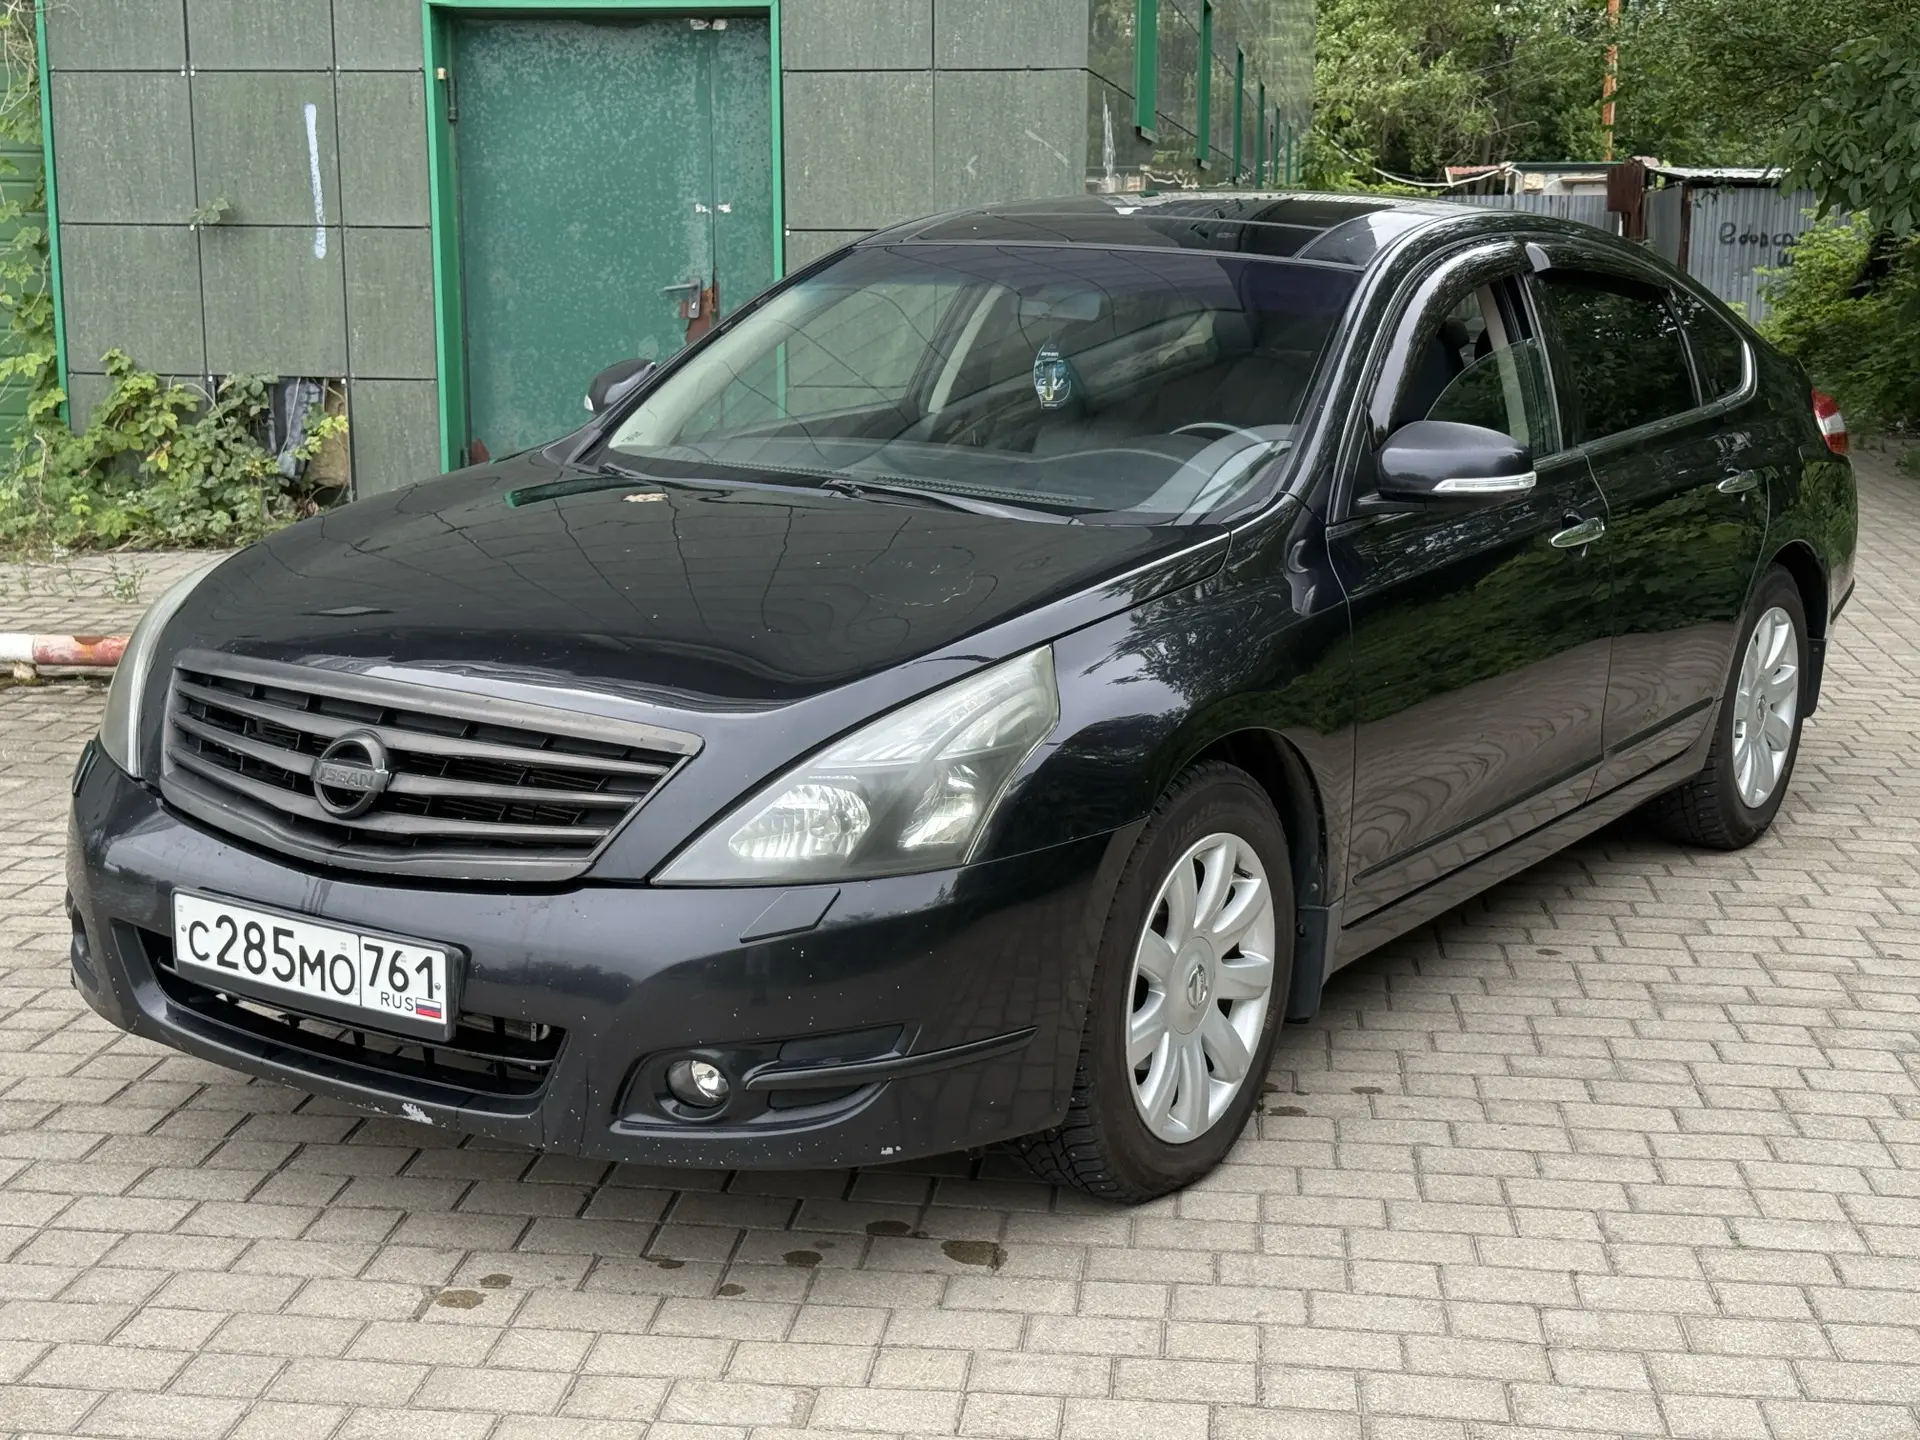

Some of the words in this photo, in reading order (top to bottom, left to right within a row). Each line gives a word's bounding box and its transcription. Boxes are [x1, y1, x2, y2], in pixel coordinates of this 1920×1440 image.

[315, 766, 374, 789] NISSAN
[363, 943, 435, 1000] 761
[380, 992, 414, 1012] RUS
